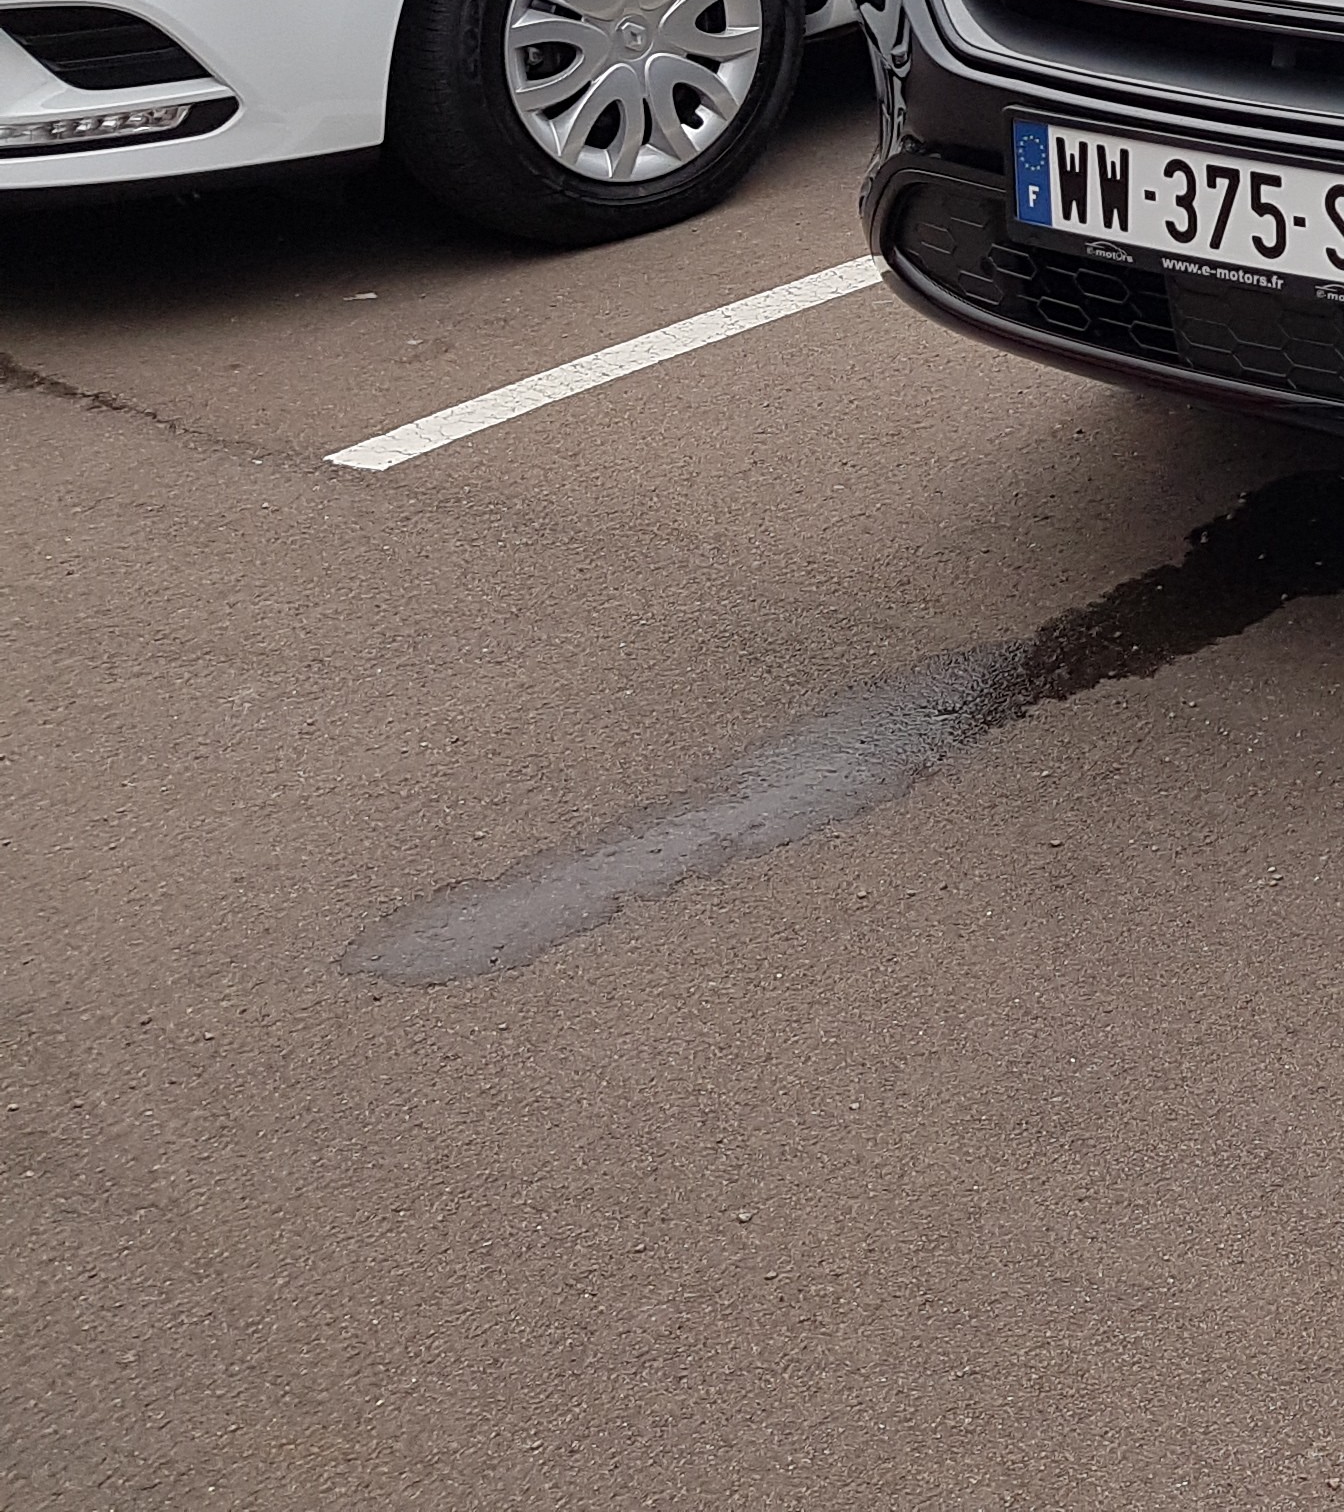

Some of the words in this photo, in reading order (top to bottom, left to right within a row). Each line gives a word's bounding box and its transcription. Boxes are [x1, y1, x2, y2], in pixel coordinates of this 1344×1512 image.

[1028, 185, 1040, 207] F
[1086, 247, 1134, 263] e-motors
[1161, 257, 1285, 290] www.e-motors.fr
